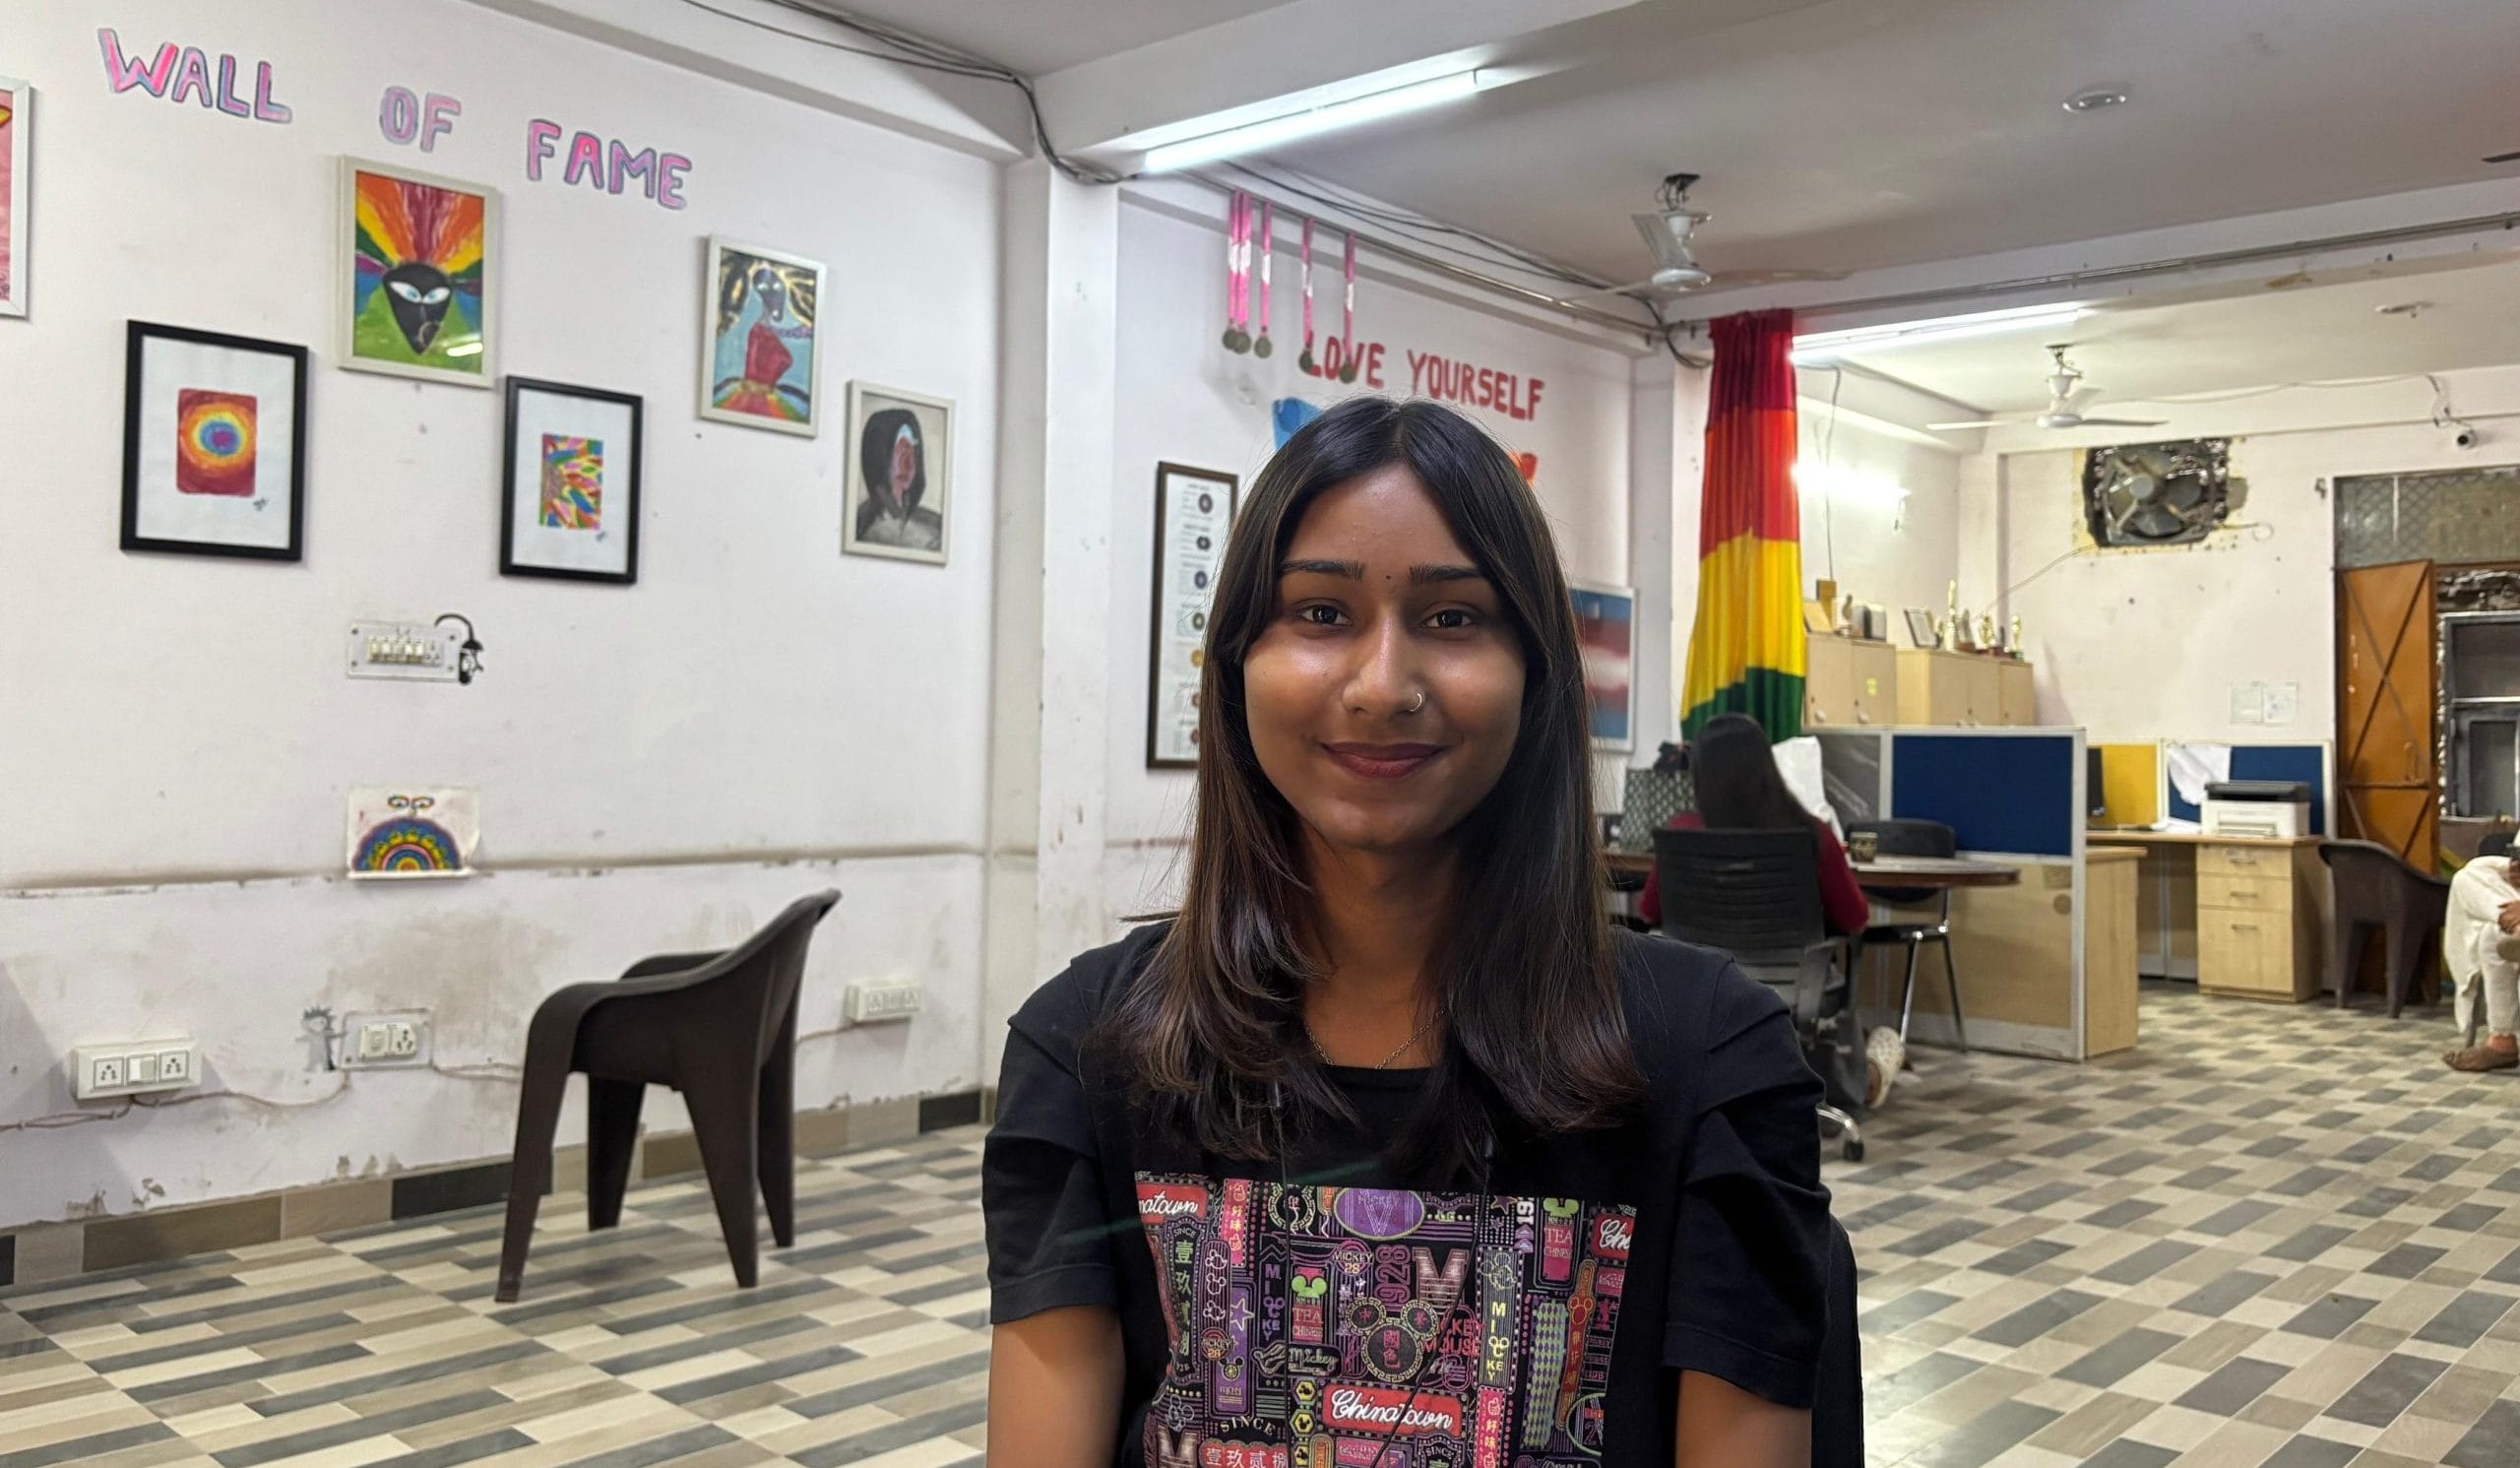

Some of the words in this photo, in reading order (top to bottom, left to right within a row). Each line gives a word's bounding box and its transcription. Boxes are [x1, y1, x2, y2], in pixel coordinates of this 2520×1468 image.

[97, 28, 292, 124] WALL
[379, 86, 462, 153] OF
[526, 118, 693, 211] FAME
[1307, 330, 1386, 389] LOVE
[1407, 349, 1545, 421] YOURSELF
[1544, 1227, 1573, 1245] TEA
[1333, 1250, 1373, 1264] MICKEY
[1344, 1262, 1360, 1275] 28
[1292, 1307, 1324, 1323] TEA
[1221, 1416, 1277, 1436] SINCE
[1425, 1445, 1455, 1460] SINCE
